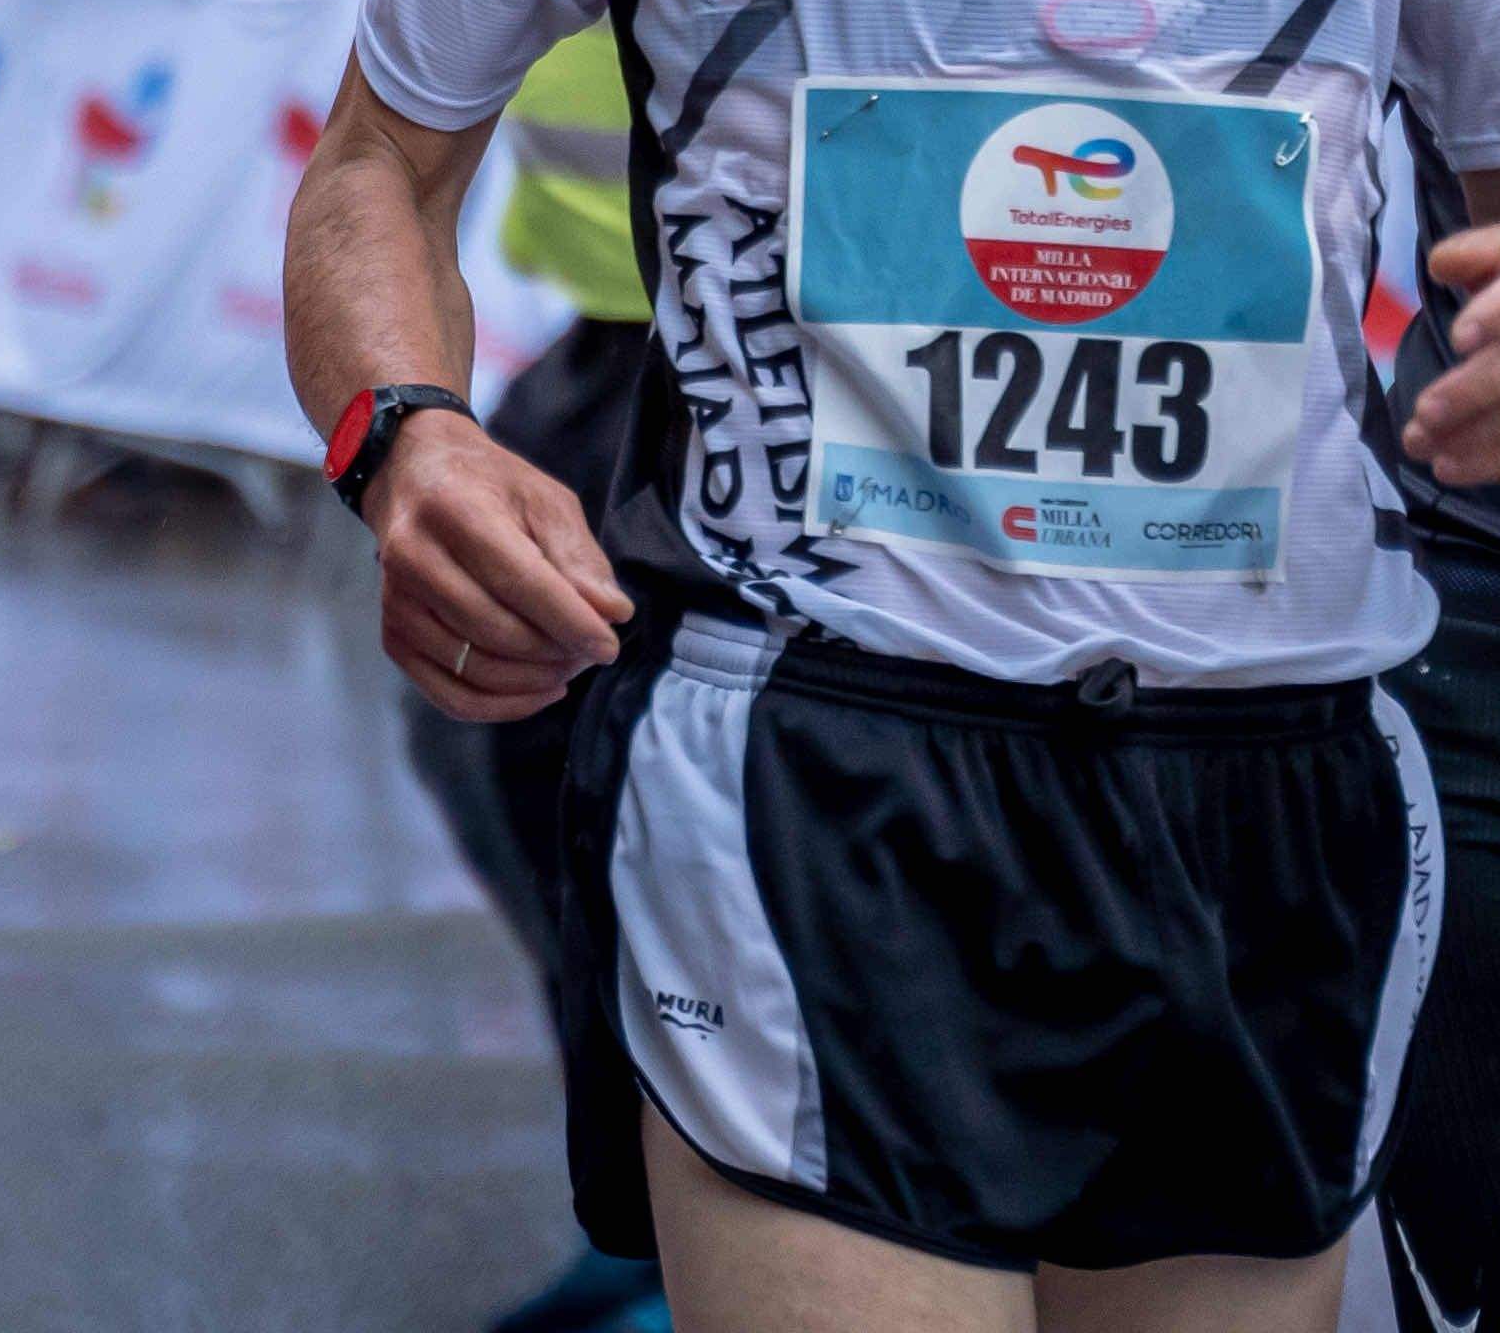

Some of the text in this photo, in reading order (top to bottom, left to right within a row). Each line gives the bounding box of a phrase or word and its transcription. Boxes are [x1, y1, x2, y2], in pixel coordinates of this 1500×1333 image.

[1009, 208, 1132, 233] TotalEnergies
[1036, 249, 1092, 267] MILLA
[1011, 287, 1112, 307] DE MADRID
[905, 330, 1215, 484] 1243
[870, 482, 972, 526] MADRD
[1040, 509, 1101, 528] MILLA
